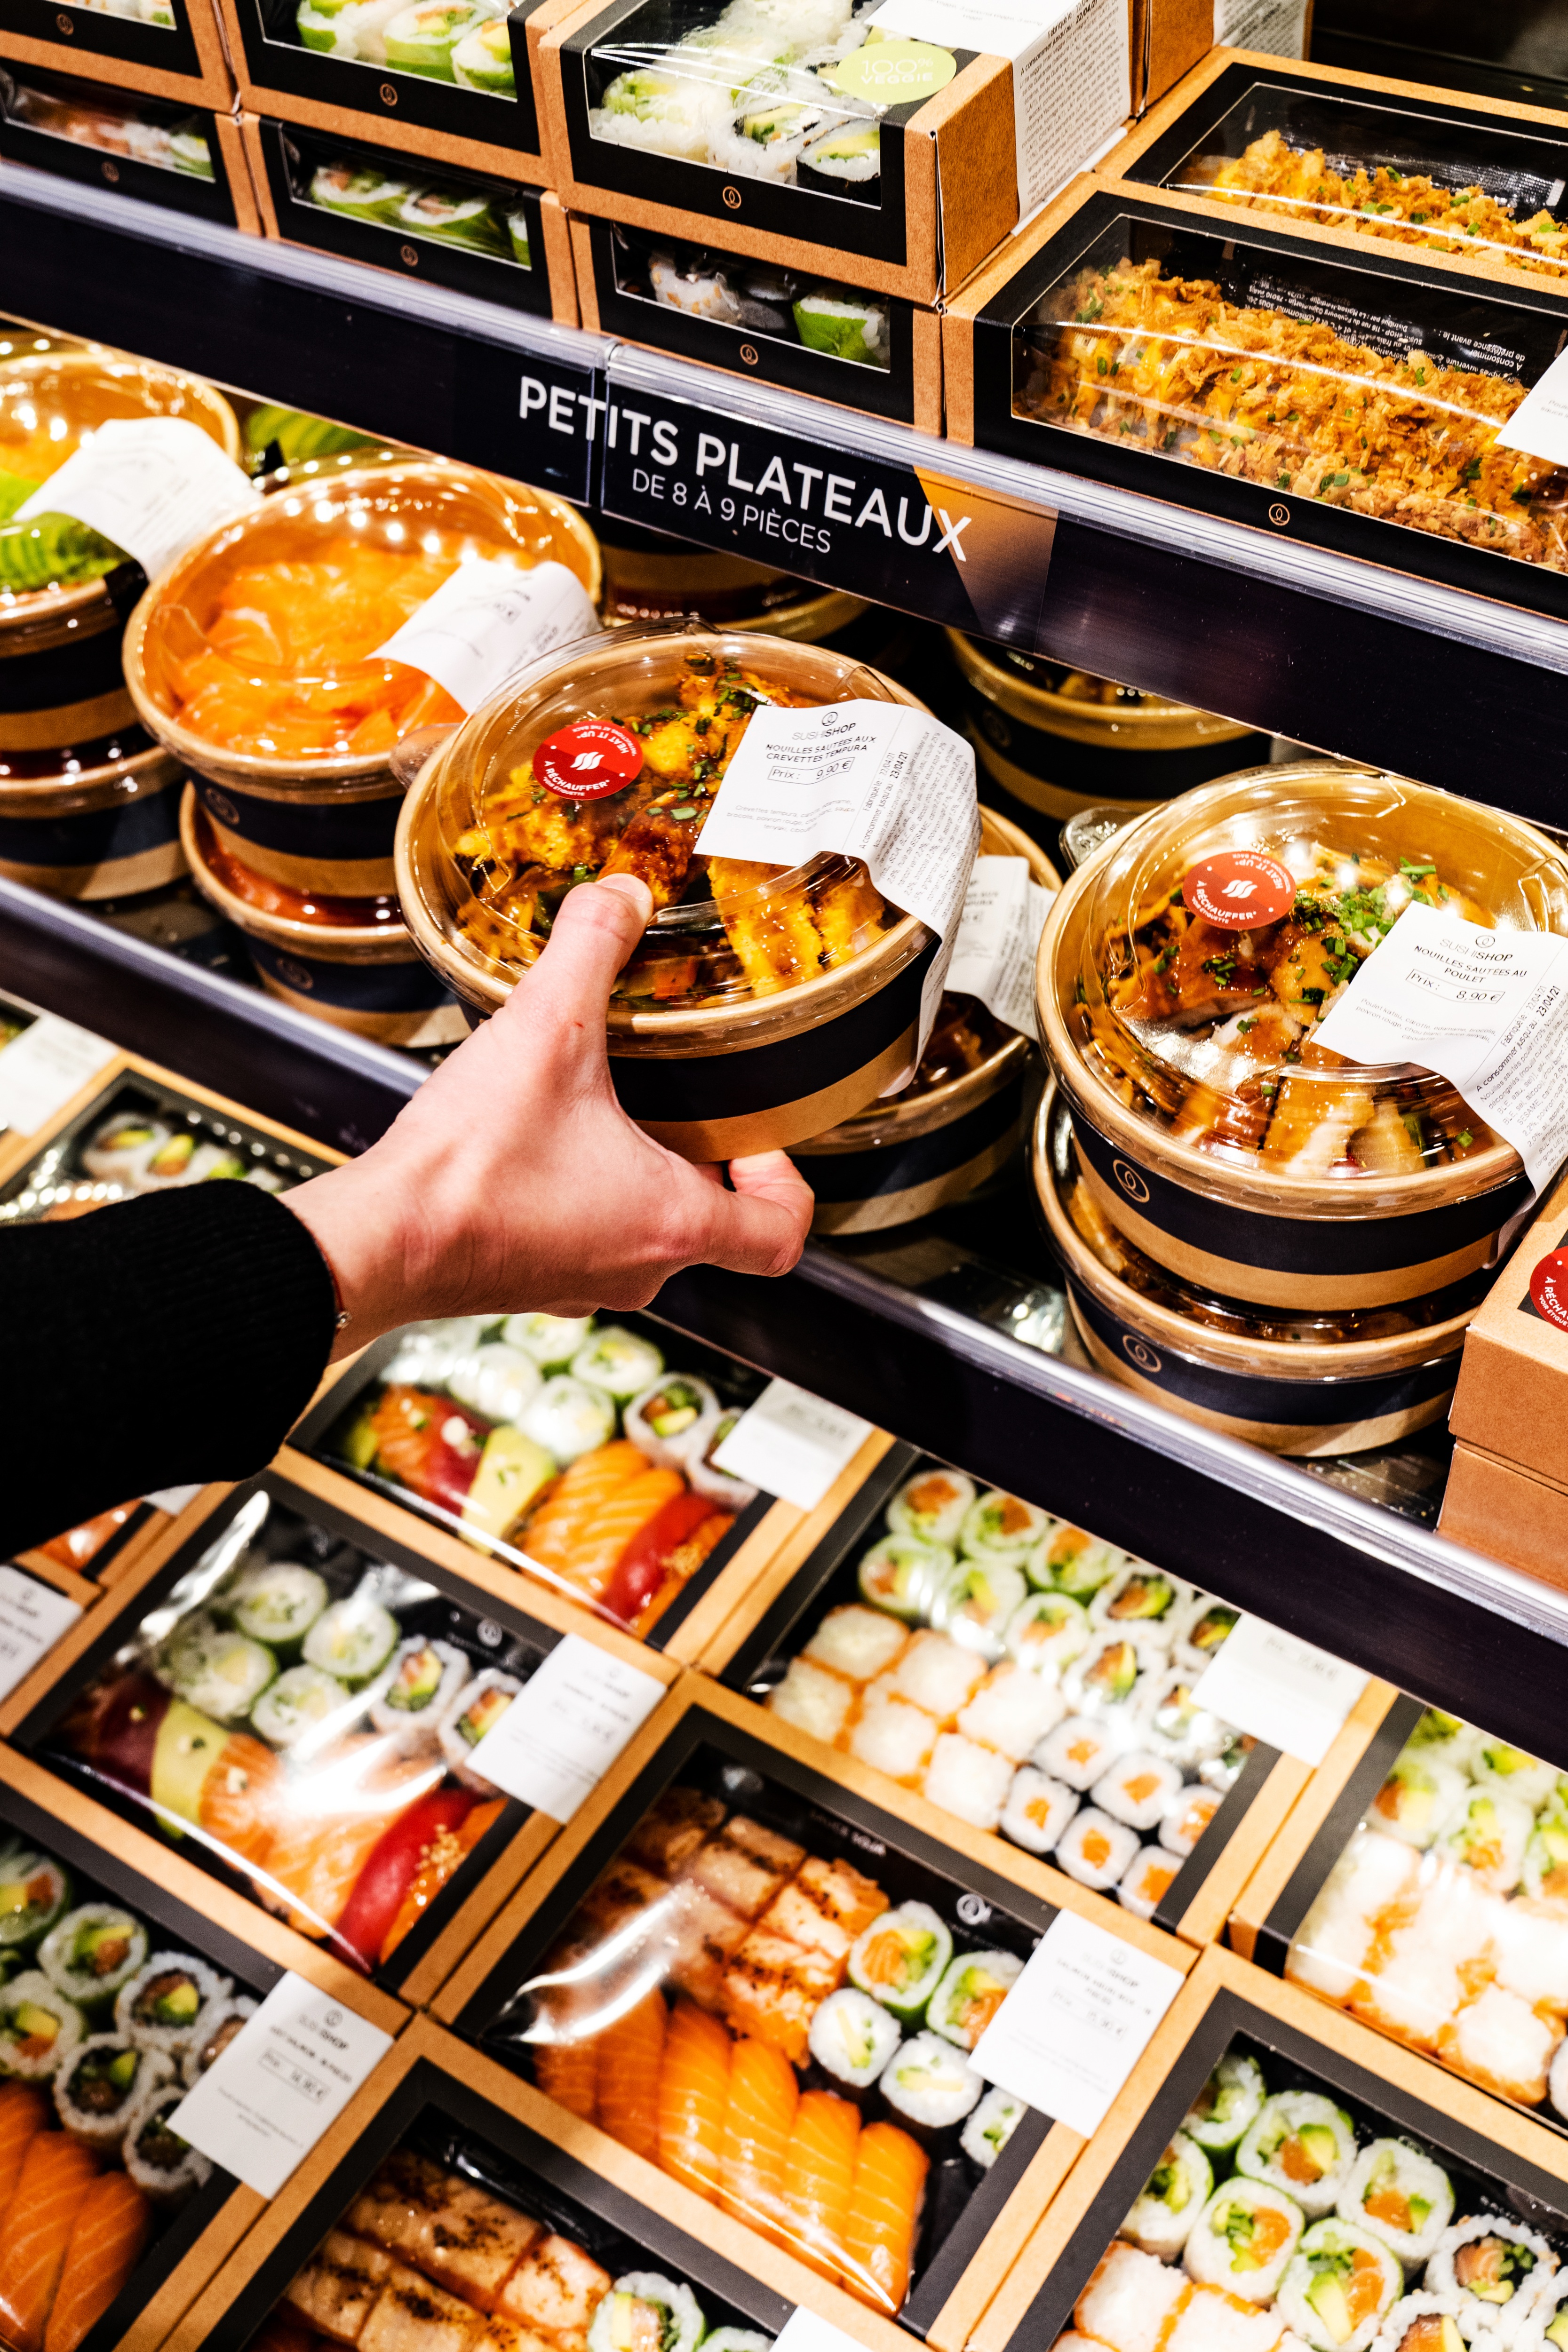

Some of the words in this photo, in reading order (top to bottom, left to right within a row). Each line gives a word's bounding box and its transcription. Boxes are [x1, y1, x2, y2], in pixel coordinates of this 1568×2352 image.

[862, 57, 934, 76] 100%
[861, 72, 934, 85] VEGGIE
[1449, 333, 1472, 347] avant
[1515, 352, 1526, 363] de
[519, 375, 679, 466] PETITS
[695, 432, 973, 563] PLATEAUX
[632, 469, 665, 500] DE
[672, 482, 688, 507] 8
[693, 485, 714, 515] À
[720, 498, 737, 522] 9
[742, 503, 833, 555] PIÈCES
[608, 734, 629, 754] HEAT
[765, 743, 813, 755] NOUILLES
[814, 737, 853, 754] SAUTÉES
[853, 735, 877, 744] AUX
[766, 753, 823, 763] CREVETTES
[825, 744, 868, 760] TEMPURA
[772, 769, 794, 779] Prix
[816, 763, 839, 780] 9,90
[842, 760, 852, 770] €
[862, 809, 882, 844] consommer
[890, 752, 909, 779] 23/04/21
[1256, 863, 1267, 871] IT
[1266, 869, 1283, 889] HEAT
[1414, 945, 1464, 969] NOUILLES
[1465, 963, 1511, 977] SAUTÉES
[1511, 969, 1528, 978] AU
[1444, 967, 1487, 984] POULET
[1410, 972, 1435, 989] Prix
[1456, 990, 1487, 1002] 8,90
[1489, 993, 1501, 1002] €
[1361, 998, 1383, 1011] Poulet
[1355, 1006, 1381, 1020] poivron
[1405, 1026, 1422, 1035] chou
[1476, 1084, 1482, 1093] A
[1482, 1046, 1518, 1085] consommer
[1517, 1020, 1537, 1051] jusqu'au
[1536, 985, 1561, 1018] 23/04/21
[1480, 1075, 1505, 1103] Nouilles
